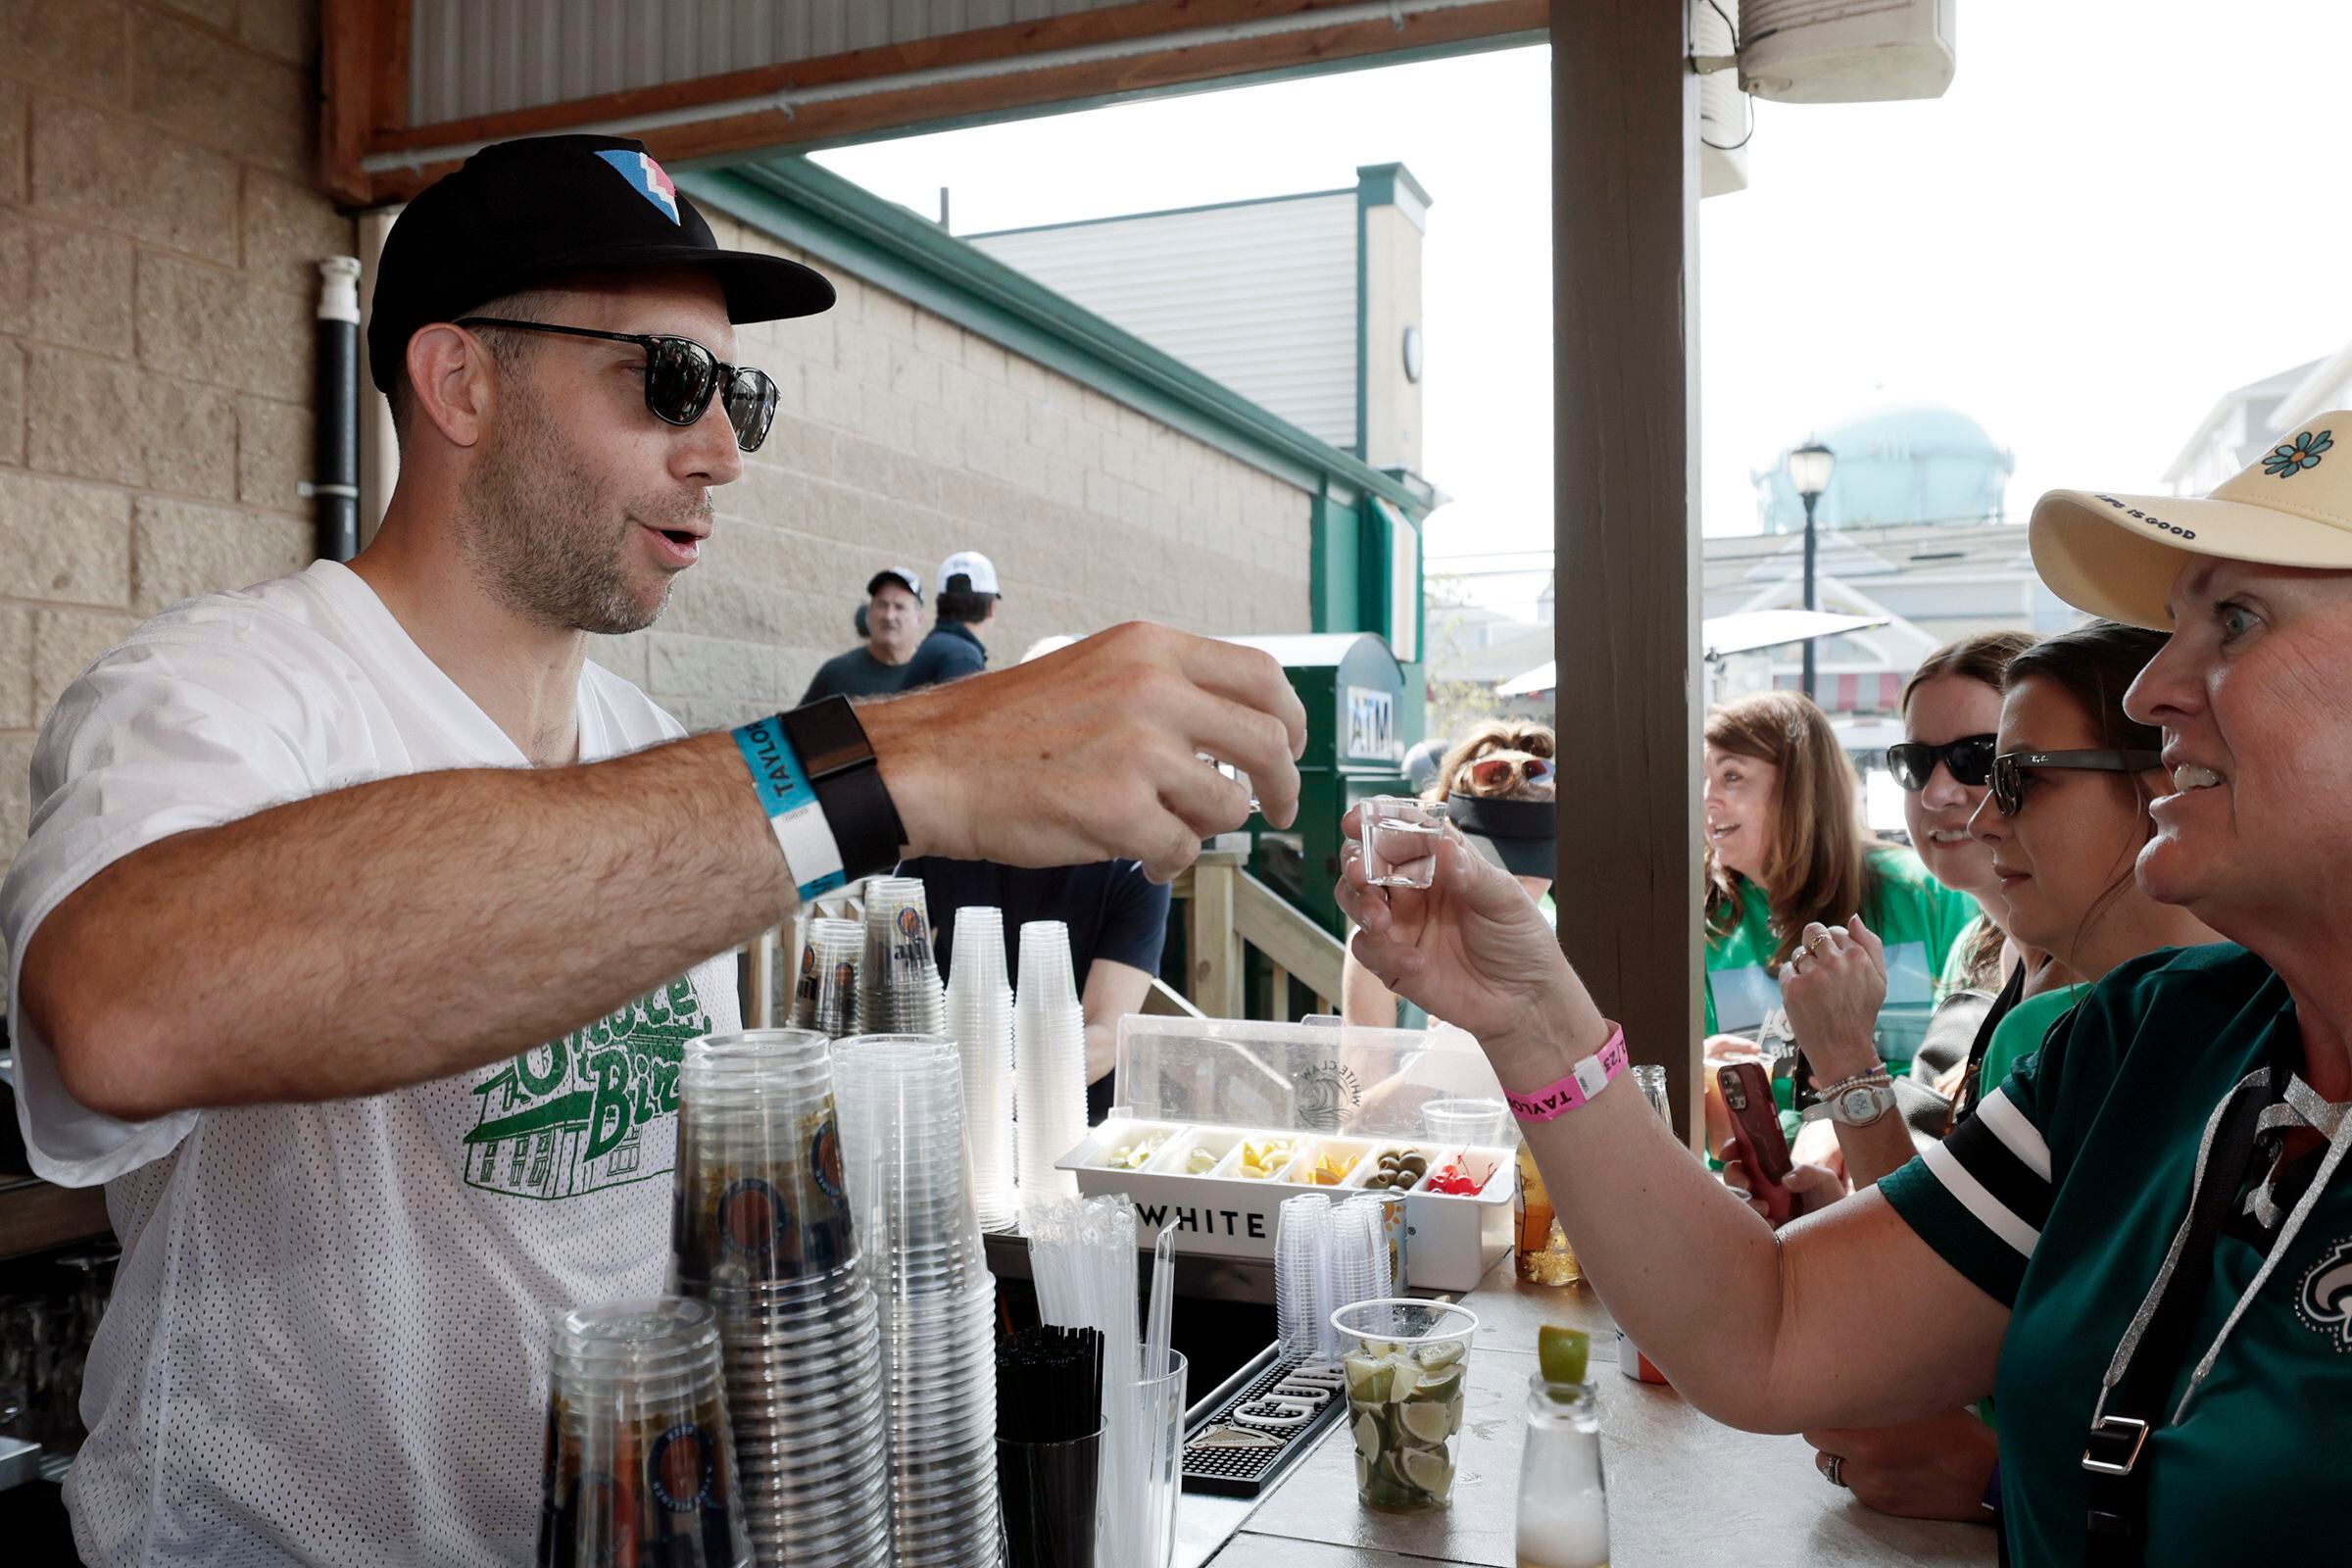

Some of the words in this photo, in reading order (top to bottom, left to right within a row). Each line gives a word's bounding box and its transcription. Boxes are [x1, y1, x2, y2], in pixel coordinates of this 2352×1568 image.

[2094, 495, 2126, 510] LIFE
[2127, 512, 2146, 520] IS
[2145, 518, 2197, 541] GOOD
[1351, 697, 1389, 754] ATM
[1134, 1201, 1267, 1239] WHITE
